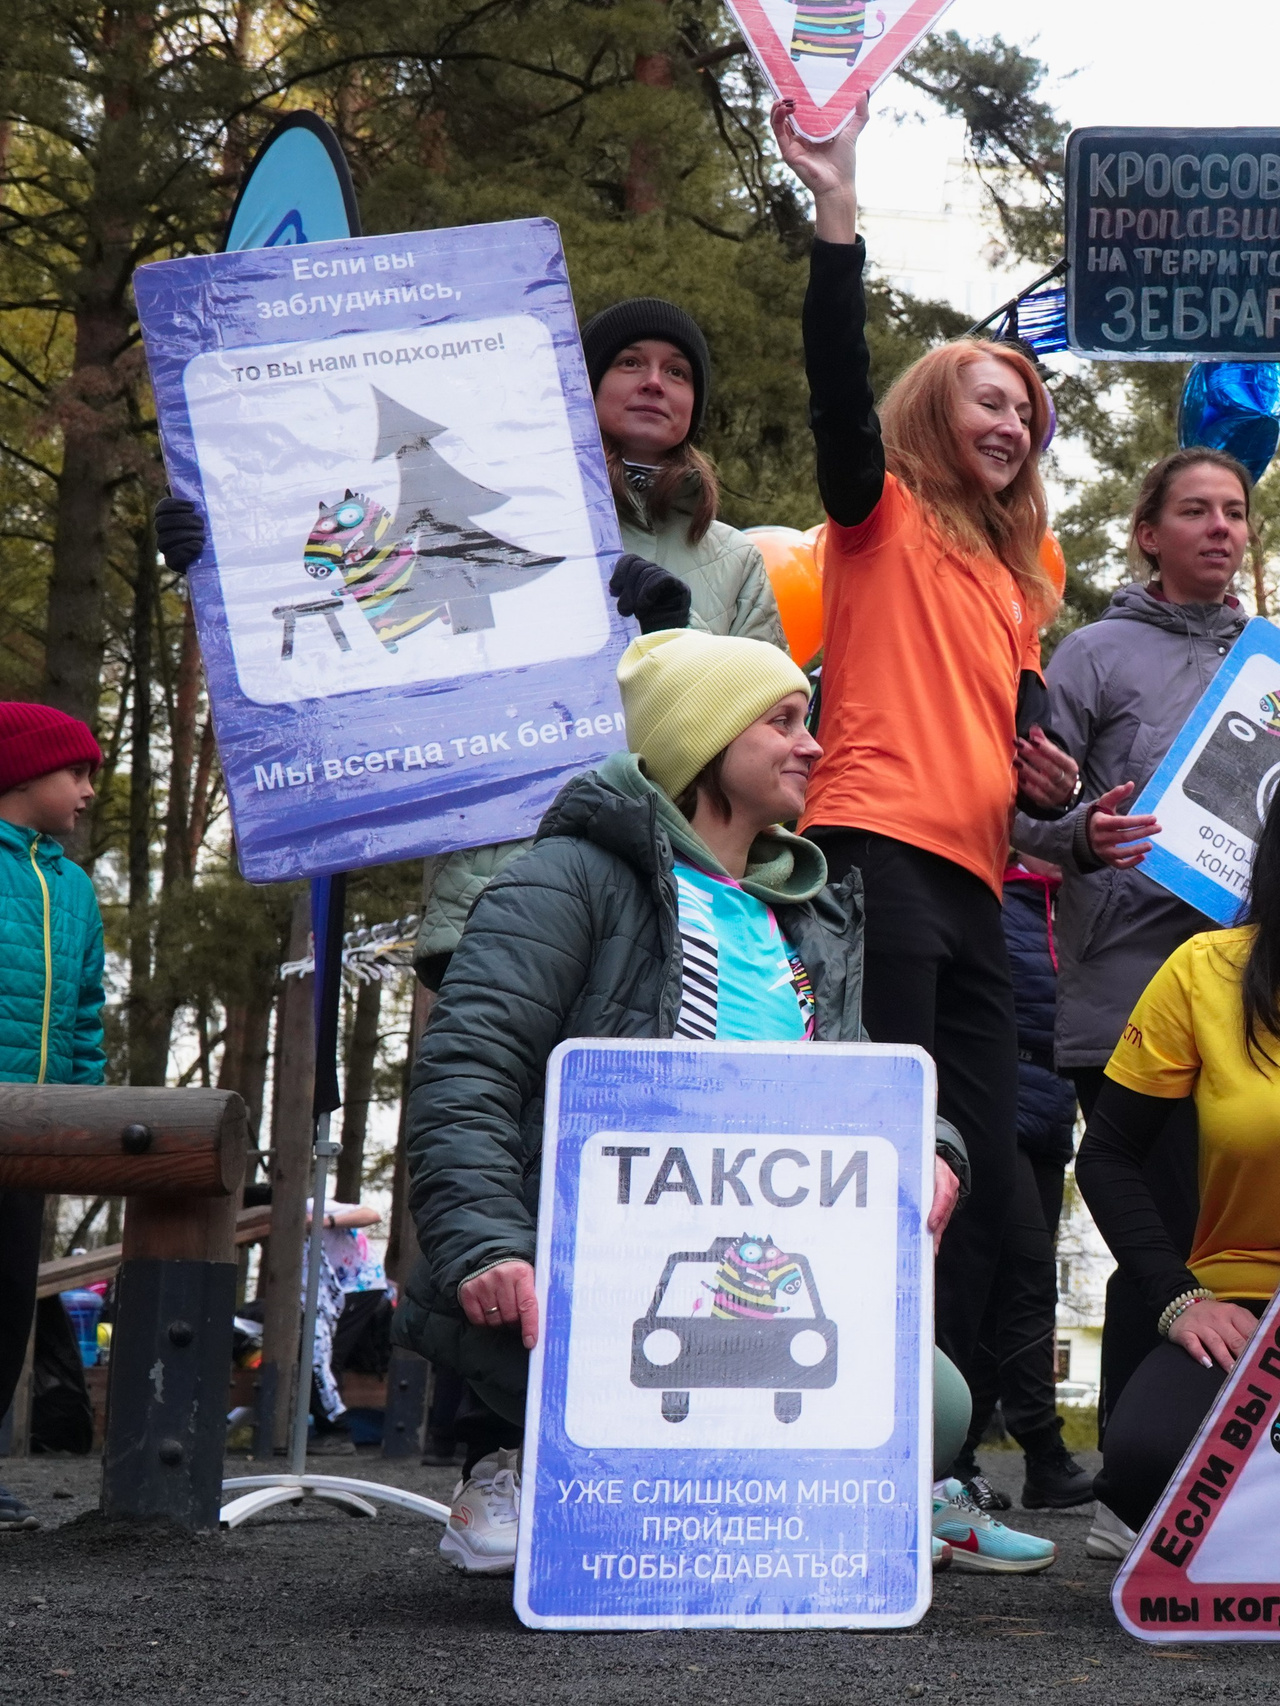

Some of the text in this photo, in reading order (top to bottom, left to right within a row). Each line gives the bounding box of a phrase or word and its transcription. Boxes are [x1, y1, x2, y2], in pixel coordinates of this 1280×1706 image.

[293, 250, 415, 281] Если вы
[1087, 246, 1127, 272] НА
[256, 282, 462, 320] заблудились,
[232, 332, 505, 383] то вы нам подходите!
[254, 761, 314, 792] Мы
[323, 742, 443, 781] всегда
[450, 731, 511, 759] так
[1199, 825, 1251, 865] ФОТО-
[601, 1146, 868, 1208] ТАКСИ
[557, 1479, 897, 1504] УЖЕ СЛИШКОМ МНОГО
[1151, 1464, 1231, 1567] Если
[1227, 1384, 1270, 1451] вы
[581, 1553, 868, 1583] ЧТОБЫ СДАВАТЬСЯ
[1140, 1597, 1199, 1622] мы
